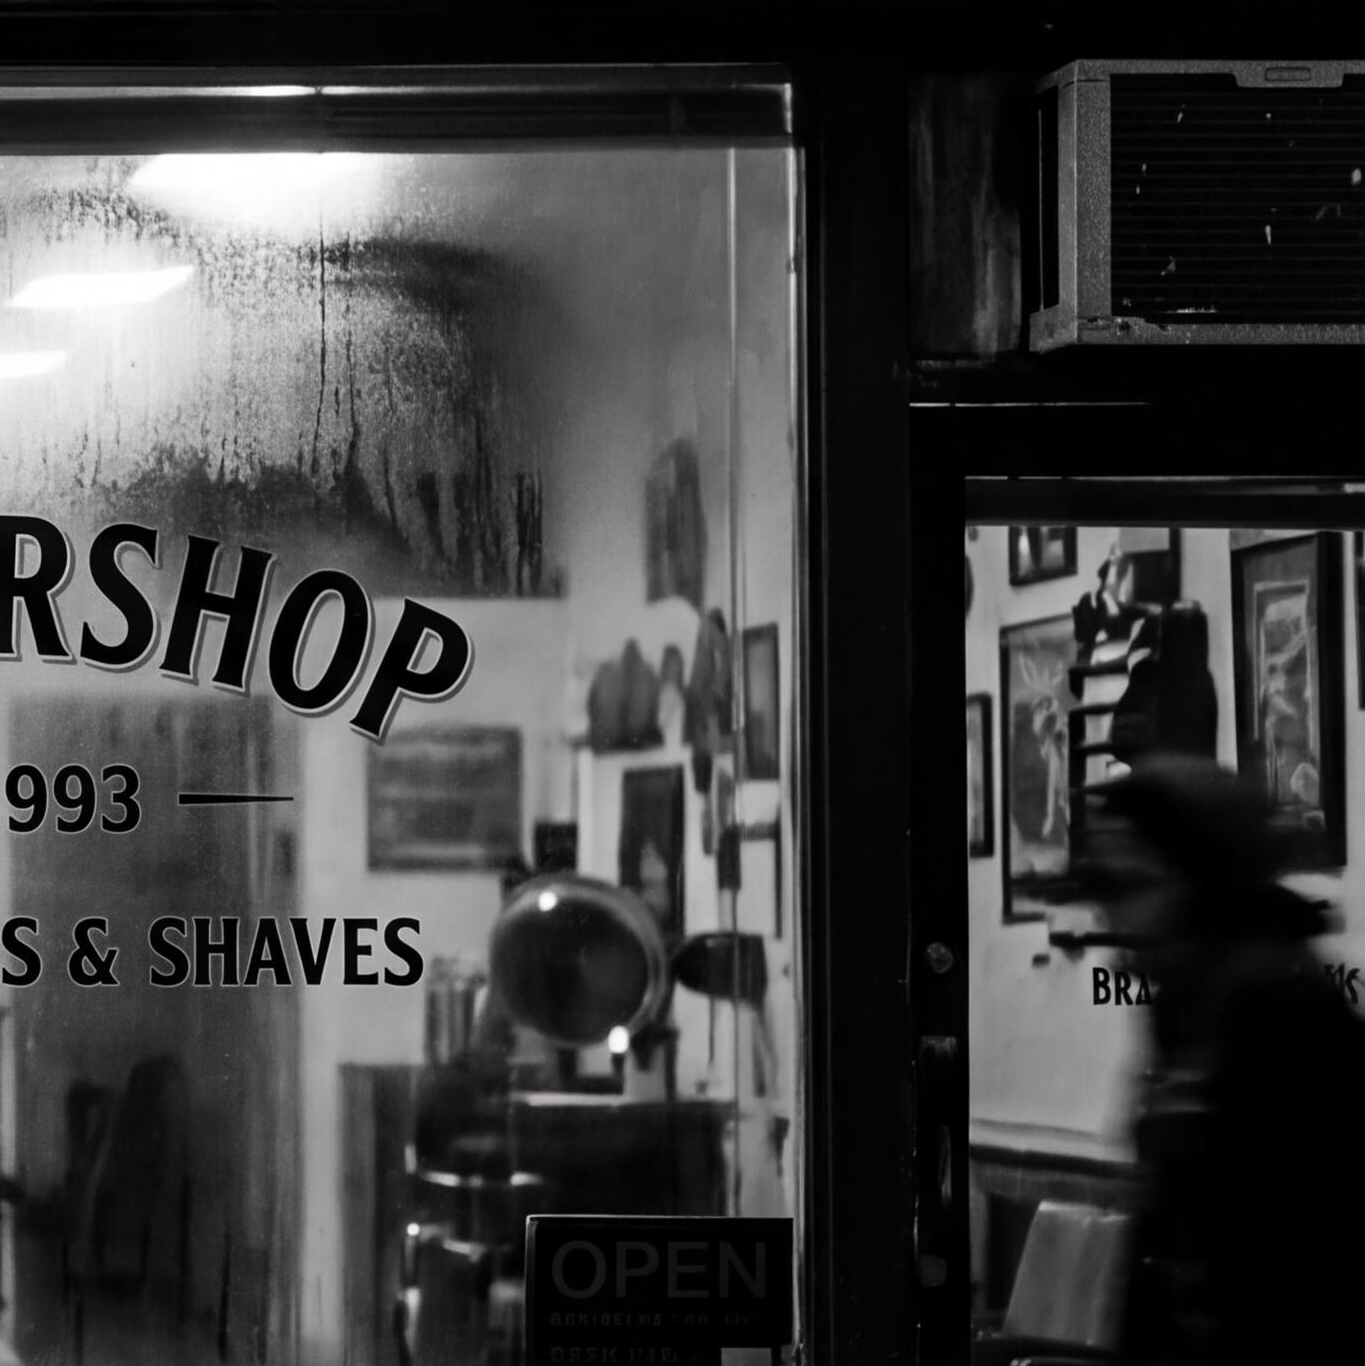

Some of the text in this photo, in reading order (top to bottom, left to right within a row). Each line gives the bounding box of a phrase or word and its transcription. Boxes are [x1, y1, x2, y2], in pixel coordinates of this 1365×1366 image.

[68, 915, 119, 987] &
[147, 914, 425, 987] SHAVES
[1092, 966, 1154, 1006] BRA
[550, 1239, 767, 1300] OPEN
